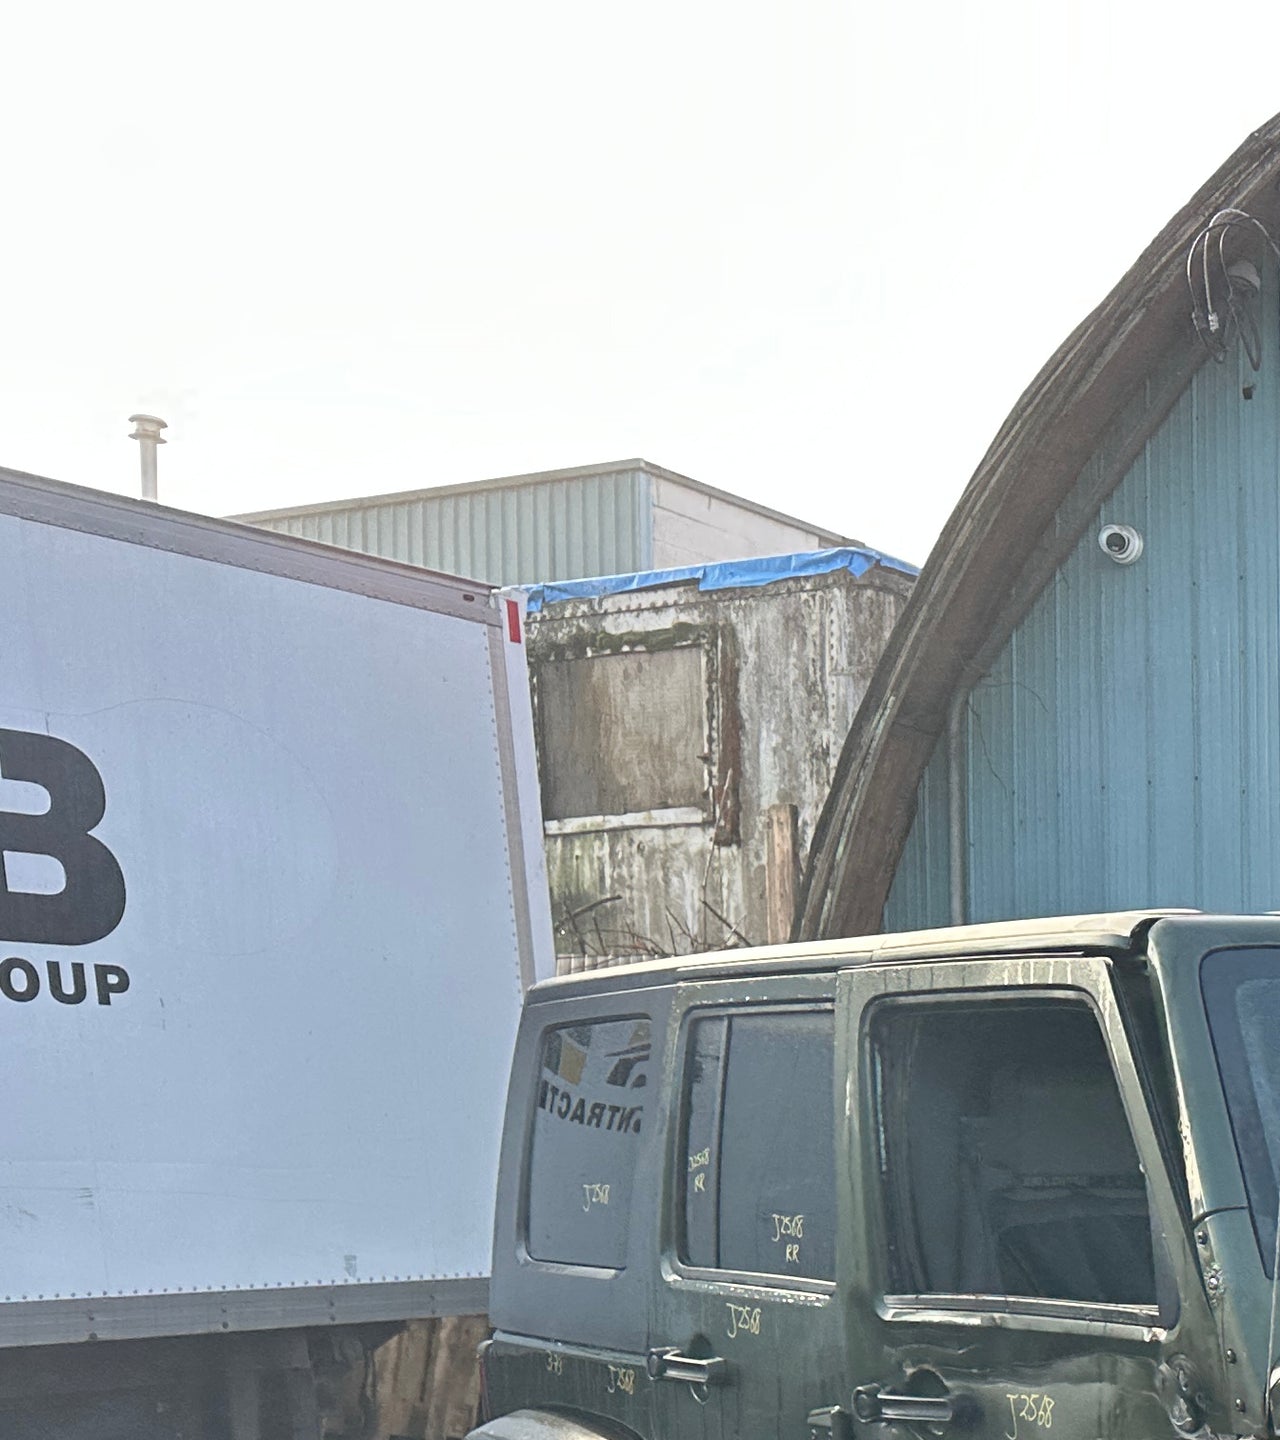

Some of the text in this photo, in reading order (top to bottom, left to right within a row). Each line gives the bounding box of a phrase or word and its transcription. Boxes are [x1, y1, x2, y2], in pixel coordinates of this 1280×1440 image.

[771, 1213, 804, 1242] J2568
[786, 1244, 800, 1263] RR
[726, 1303, 762, 1339] J2568
[1004, 1393, 1055, 1440] J2568
